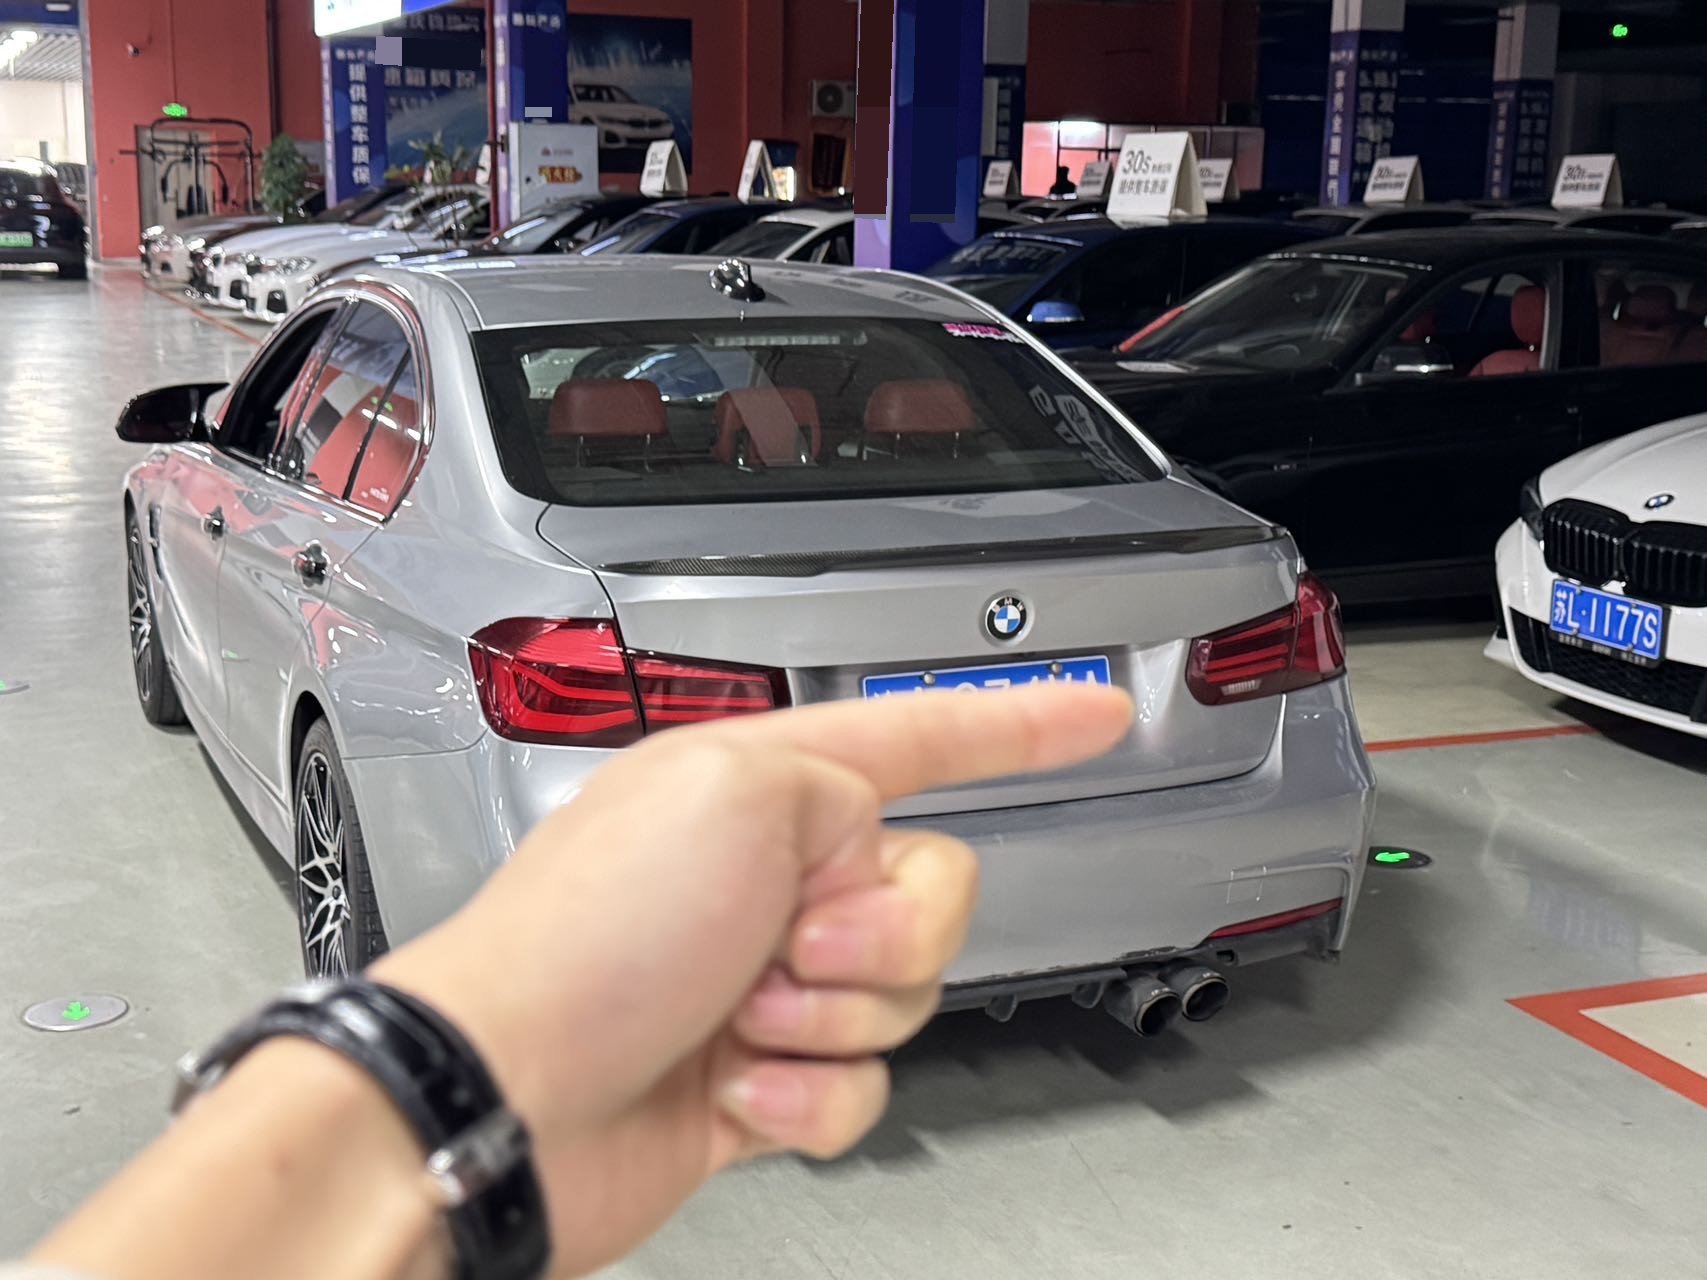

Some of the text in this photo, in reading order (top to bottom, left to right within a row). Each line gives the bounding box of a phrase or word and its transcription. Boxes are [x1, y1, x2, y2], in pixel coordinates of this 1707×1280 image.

[348, 63, 370, 184] 提供整车质保
[1122, 149, 1153, 174] 30s
